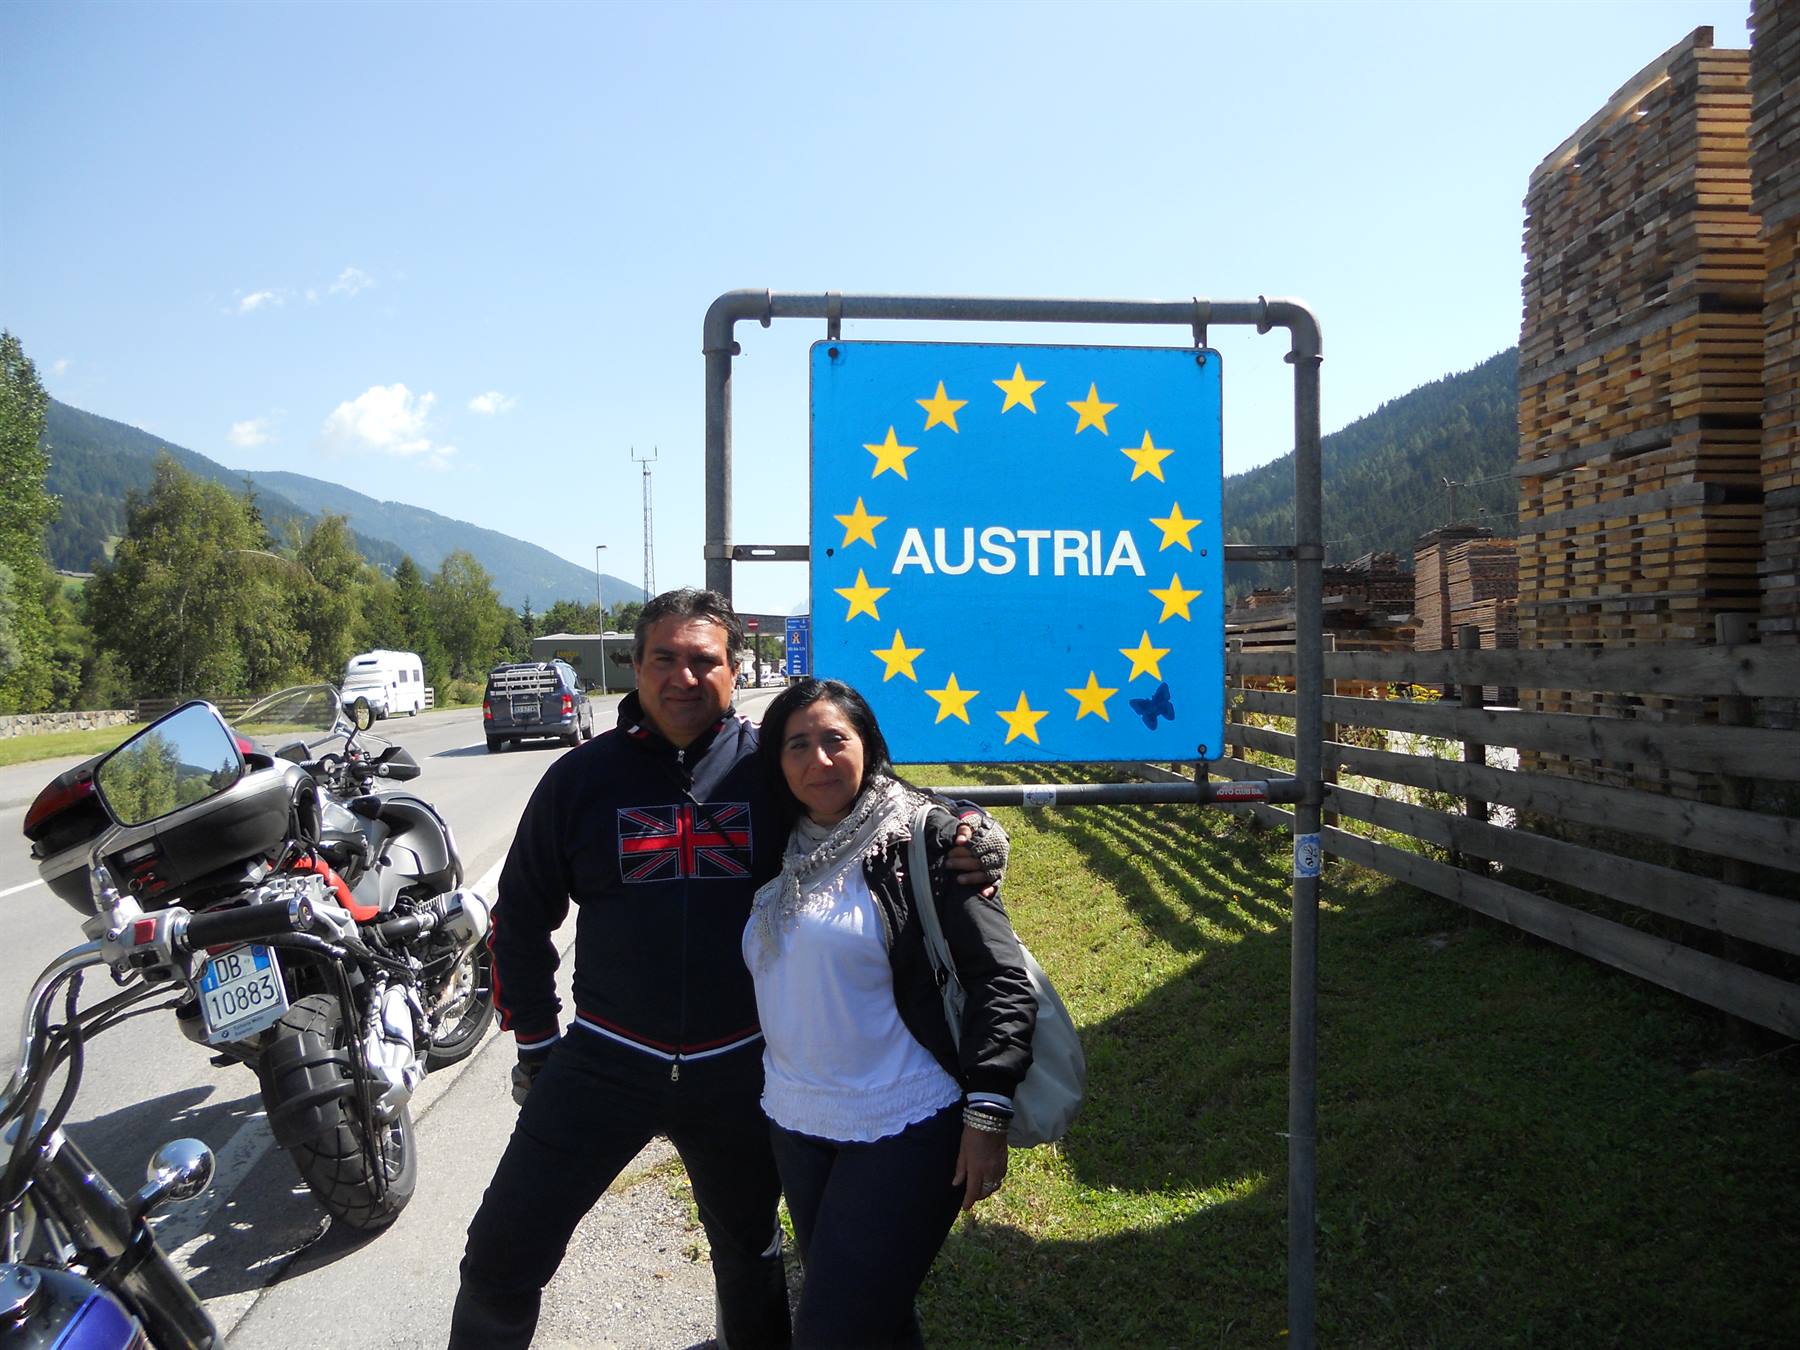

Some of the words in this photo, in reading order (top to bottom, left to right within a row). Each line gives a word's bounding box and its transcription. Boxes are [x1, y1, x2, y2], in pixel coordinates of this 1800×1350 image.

[892, 527, 1145, 577] AUSTRIA
[215, 954, 242, 983] DB
[212, 974, 274, 1020] 10883
